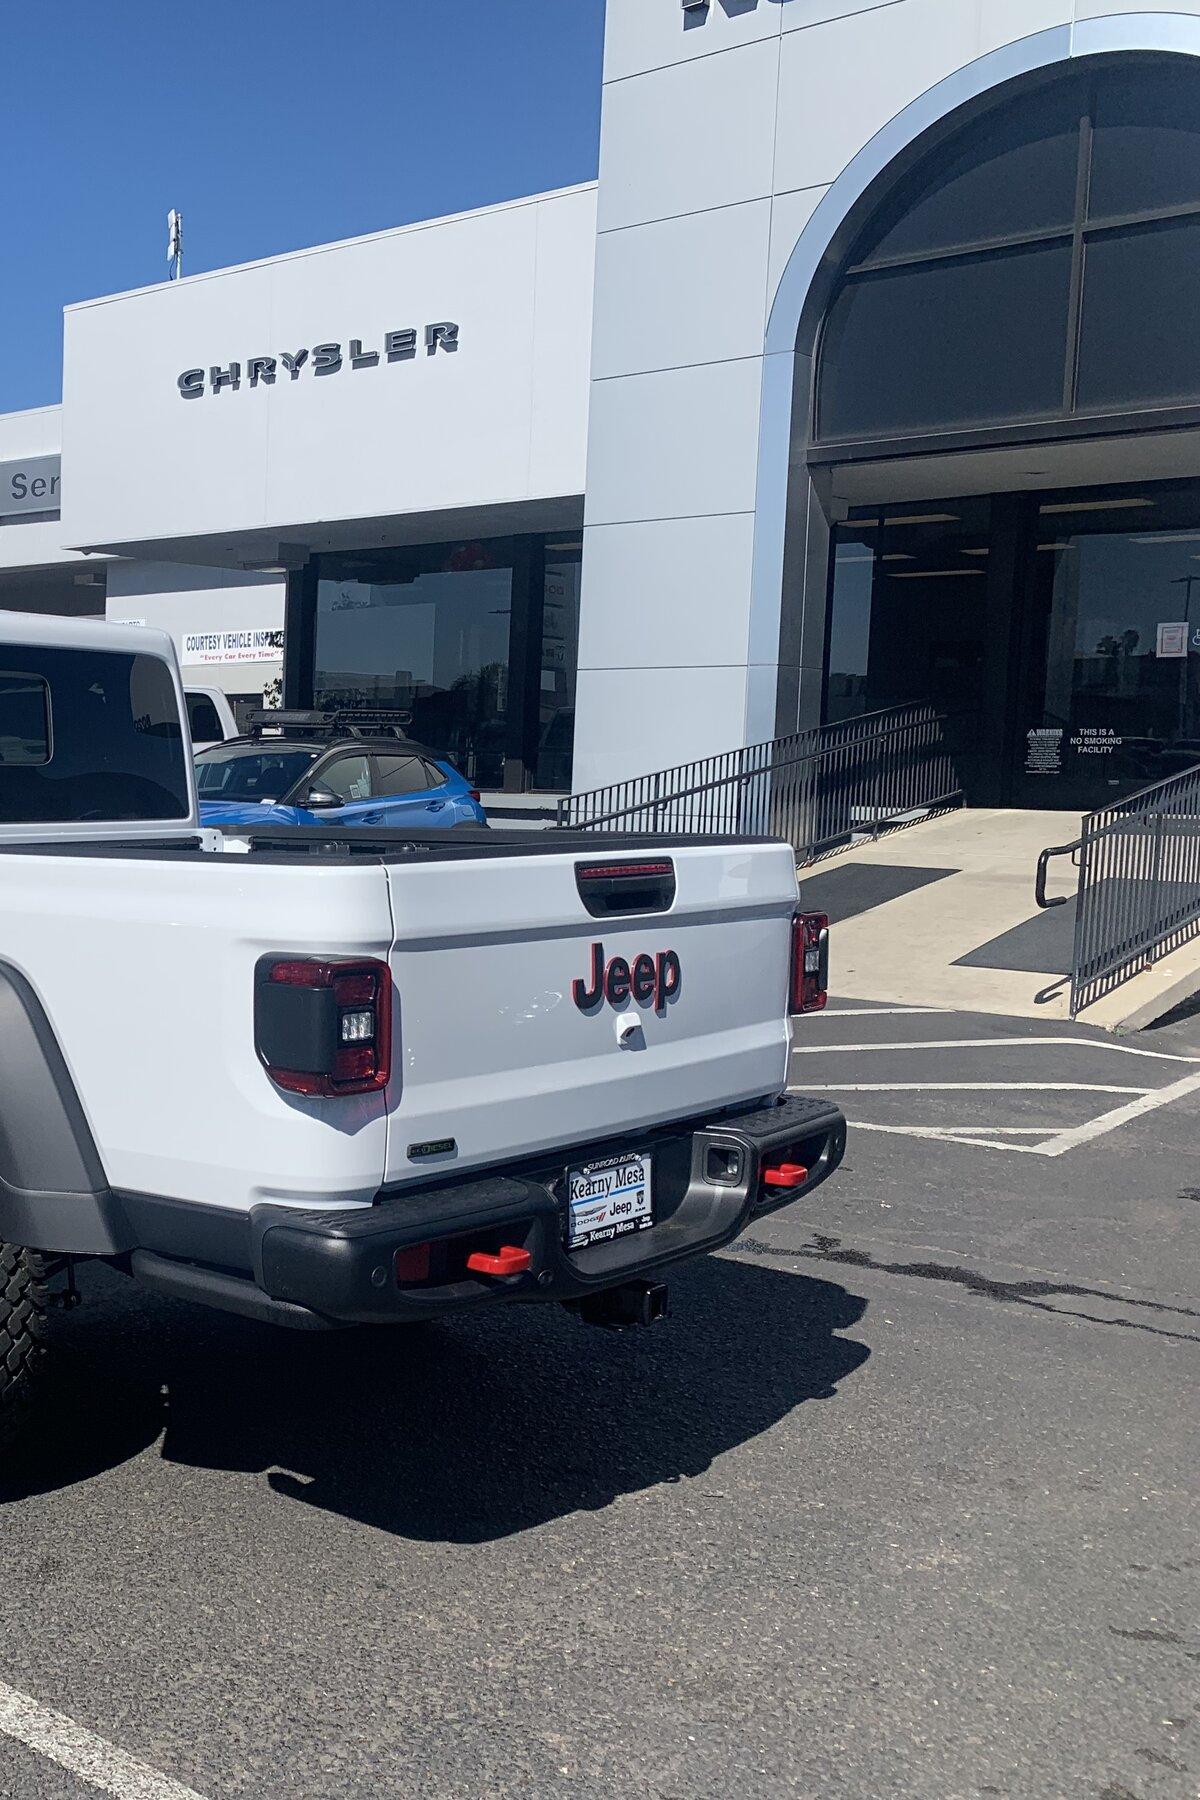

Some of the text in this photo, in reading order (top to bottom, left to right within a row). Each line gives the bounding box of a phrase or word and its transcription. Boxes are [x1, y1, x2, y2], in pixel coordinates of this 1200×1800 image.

[176, 321, 460, 393] CHRYSLER
[11, 473, 60, 499] Ser
[186, 634, 222, 652] COURTESY
[222, 632, 252, 649] VEHICLE
[238, 651, 256, 660] Every
[1069, 737, 1122, 745] NO SMOKING
[1079, 728, 1115, 736] THIS IS A
[1077, 746, 1114, 754] FACILITY
[572, 942, 680, 1012] Jeep
[570, 1167, 645, 1201] Kearny Mesa
[609, 1201, 632, 1217] Jeep
[589, 1227, 616, 1242] Kearny
[616, 1221, 635, 1234] Mesa
